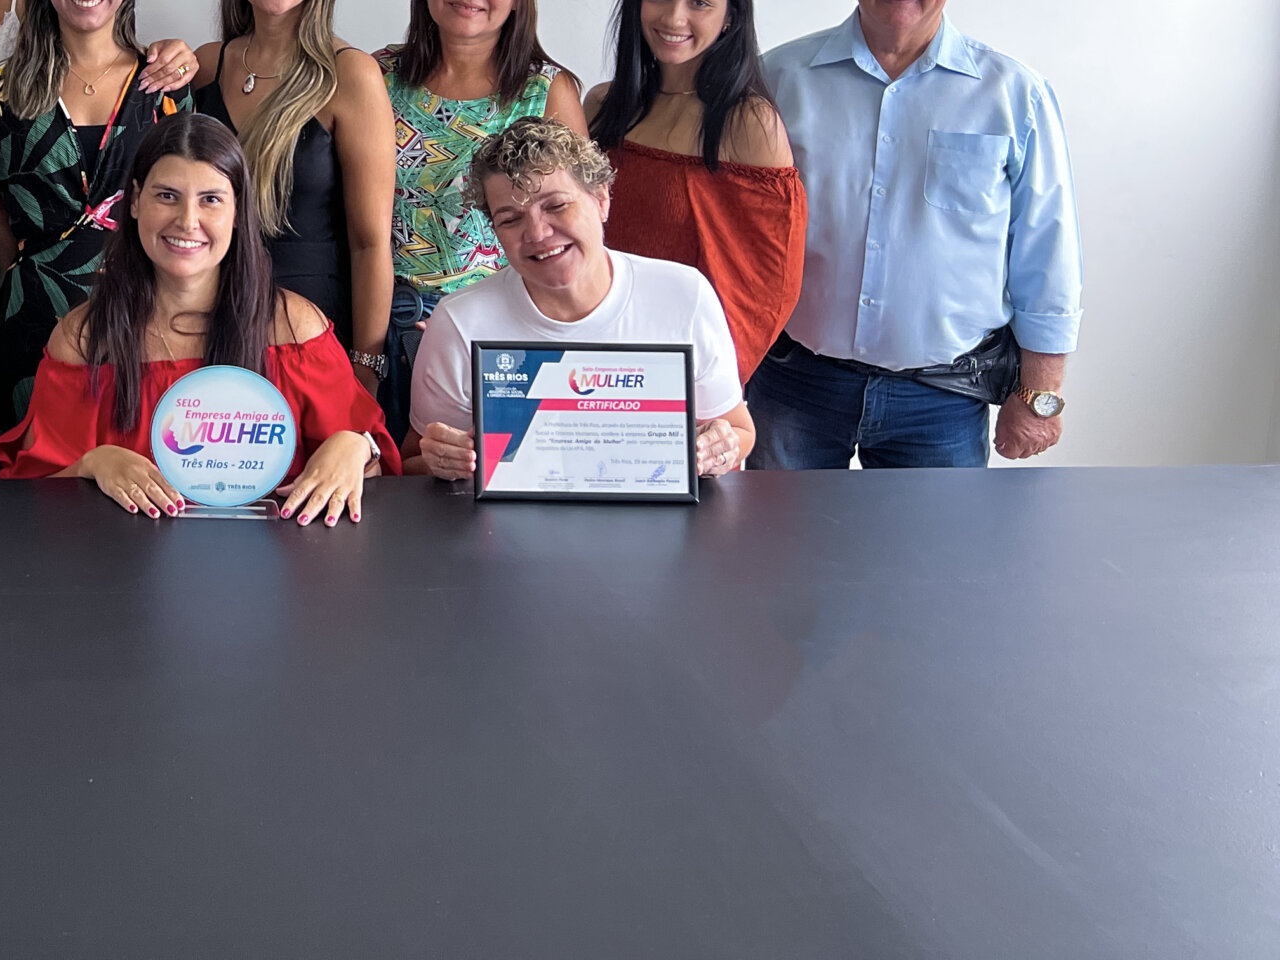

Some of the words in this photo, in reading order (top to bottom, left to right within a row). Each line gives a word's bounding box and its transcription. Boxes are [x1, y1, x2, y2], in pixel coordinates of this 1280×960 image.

[483, 371, 505, 381] TRÊS
[506, 373, 528, 381] RIOS
[580, 374, 644, 388] MULHER
[176, 398, 201, 408] SELO
[577, 401, 640, 410] CERTIFICADO
[185, 410, 231, 421] Empresa
[233, 411, 269, 423] Amiga
[272, 412, 285, 421] da
[180, 422, 286, 445] MULHER
[181, 458, 203, 469] Três
[206, 458, 228, 469] Rios
[238, 460, 265, 470] 2021
